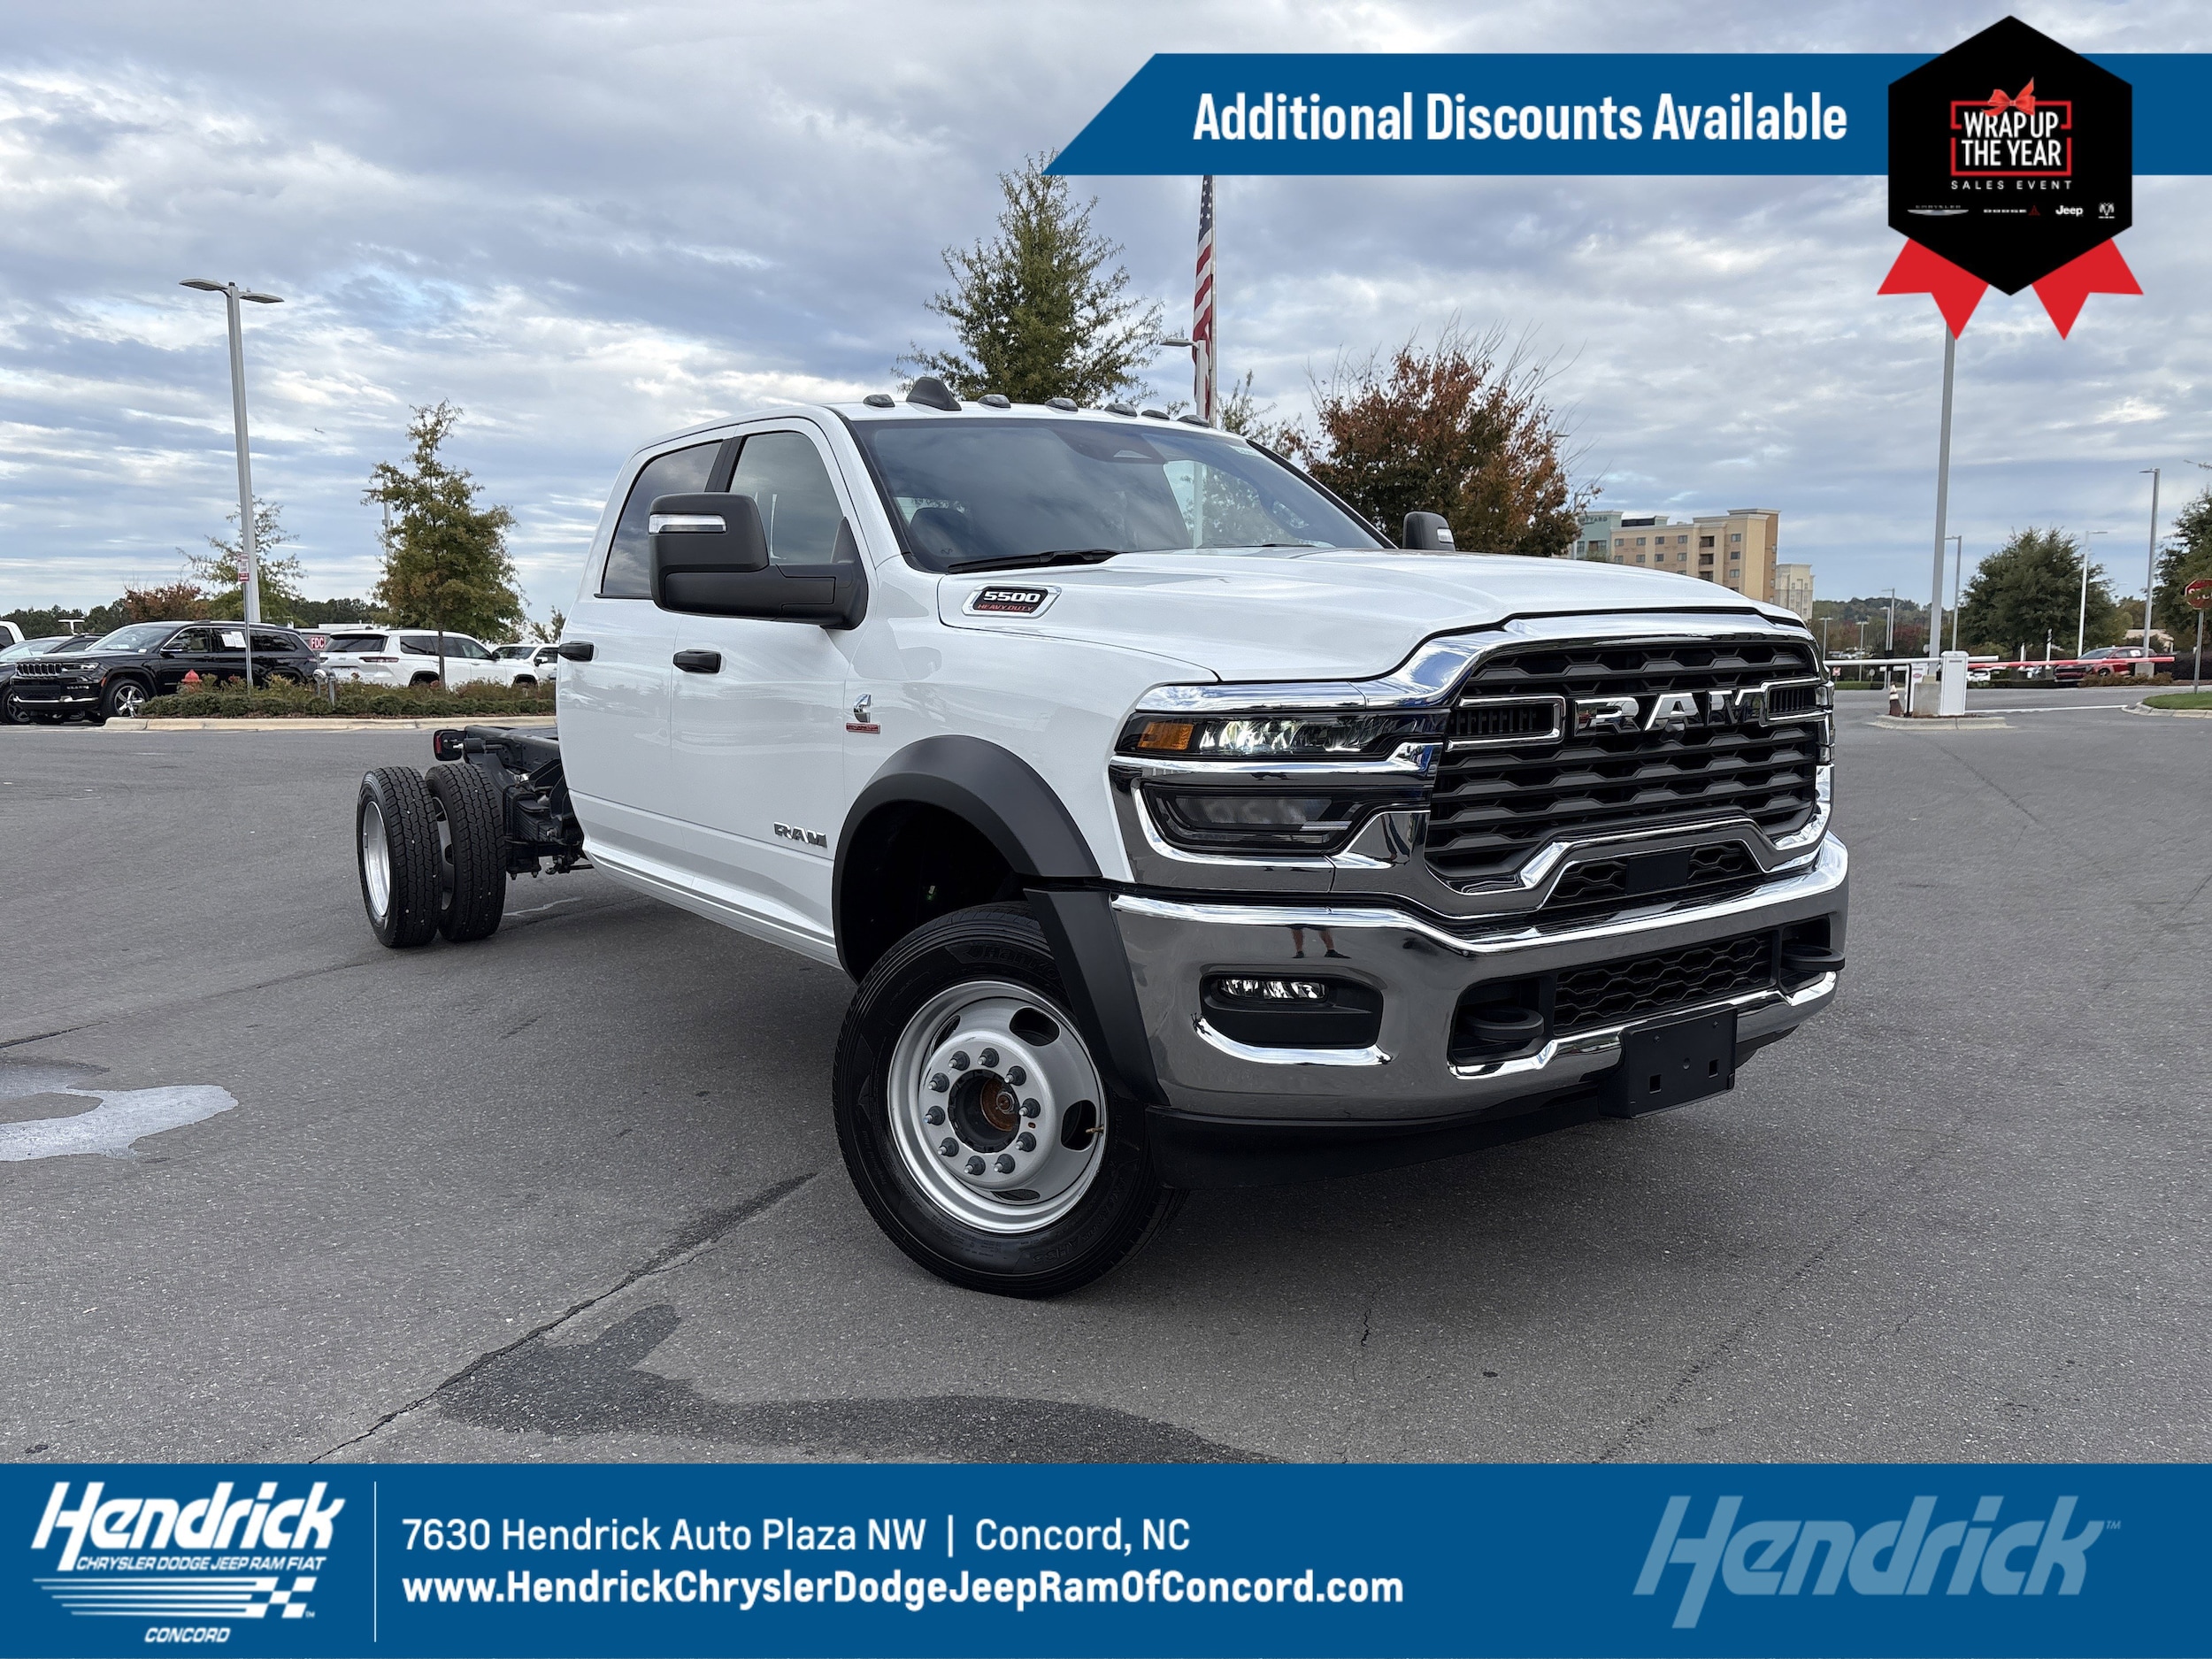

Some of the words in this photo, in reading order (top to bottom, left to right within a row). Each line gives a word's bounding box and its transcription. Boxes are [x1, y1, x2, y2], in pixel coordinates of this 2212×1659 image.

[983, 591, 1041, 603] 5500
[311, 637, 325, 649] FDC
[1573, 687, 1768, 737] RAM
[773, 821, 828, 848] RAM
